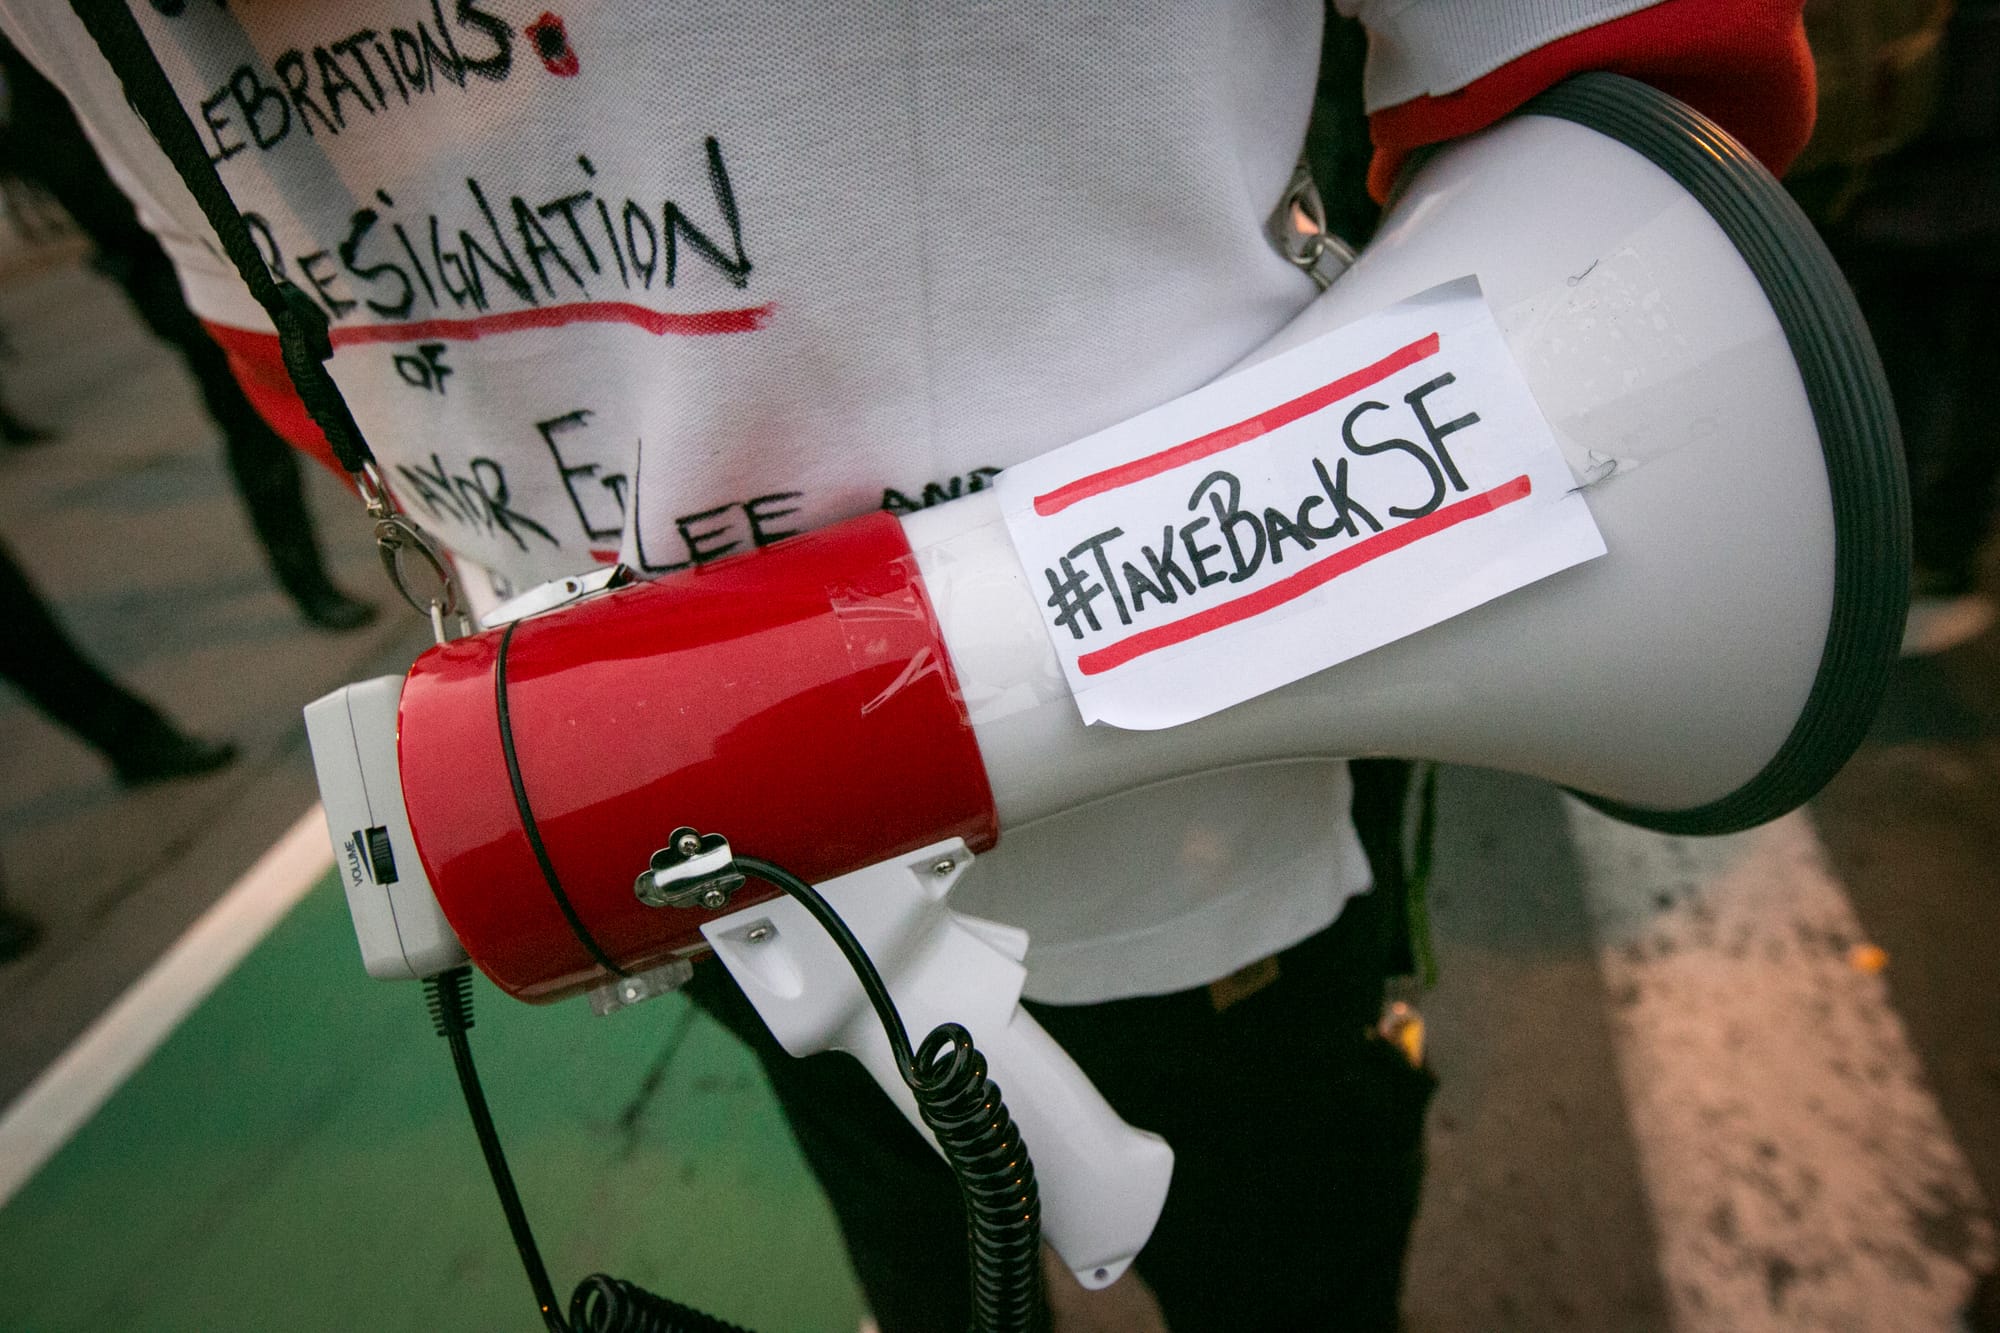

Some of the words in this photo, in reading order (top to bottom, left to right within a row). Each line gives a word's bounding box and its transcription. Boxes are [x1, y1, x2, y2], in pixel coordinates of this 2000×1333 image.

[392, 342, 455, 396] OF
[395, 451, 561, 552] AYOR
[632, 437, 804, 573] LEE
[344, 839, 364, 888] VOLUME
